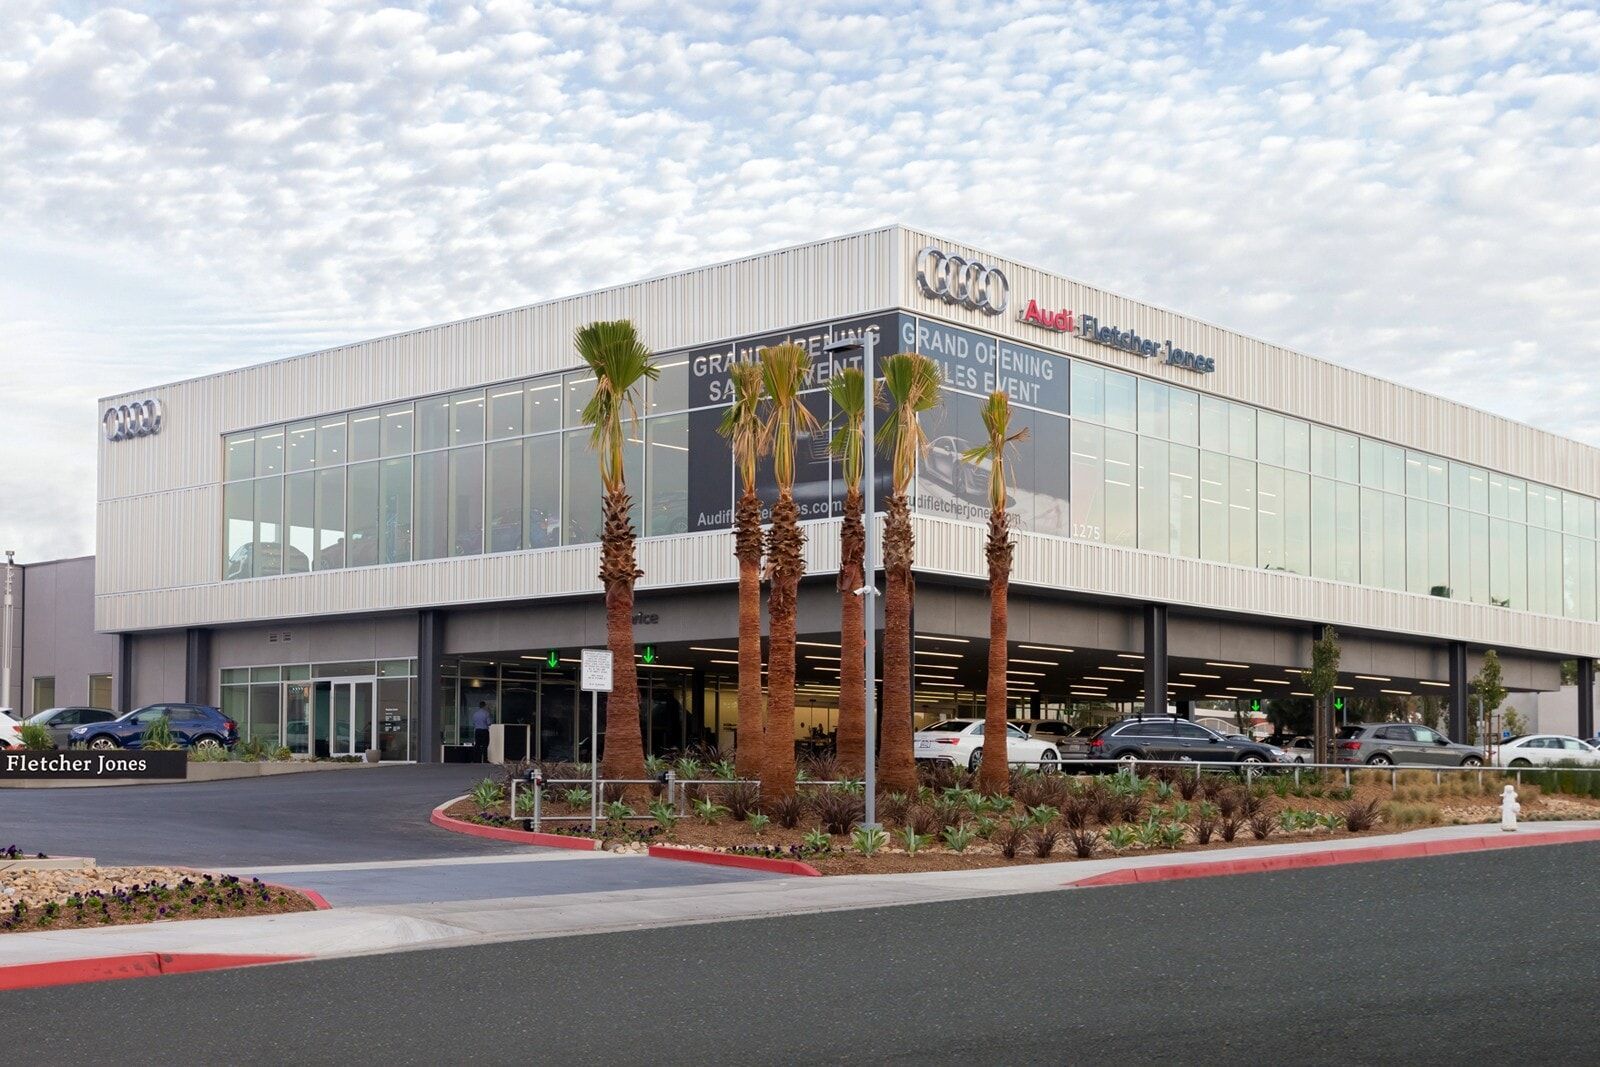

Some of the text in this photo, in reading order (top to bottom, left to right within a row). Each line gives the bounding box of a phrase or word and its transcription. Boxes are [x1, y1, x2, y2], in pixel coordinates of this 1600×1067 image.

[902, 322, 968, 359] GRAND
[1024, 299, 1215, 372] Audi Fletcher Jones
[801, 355, 864, 386] VENT
[1072, 523, 1100, 540] 1275
[6, 754, 147, 775] Fletcher Jones
